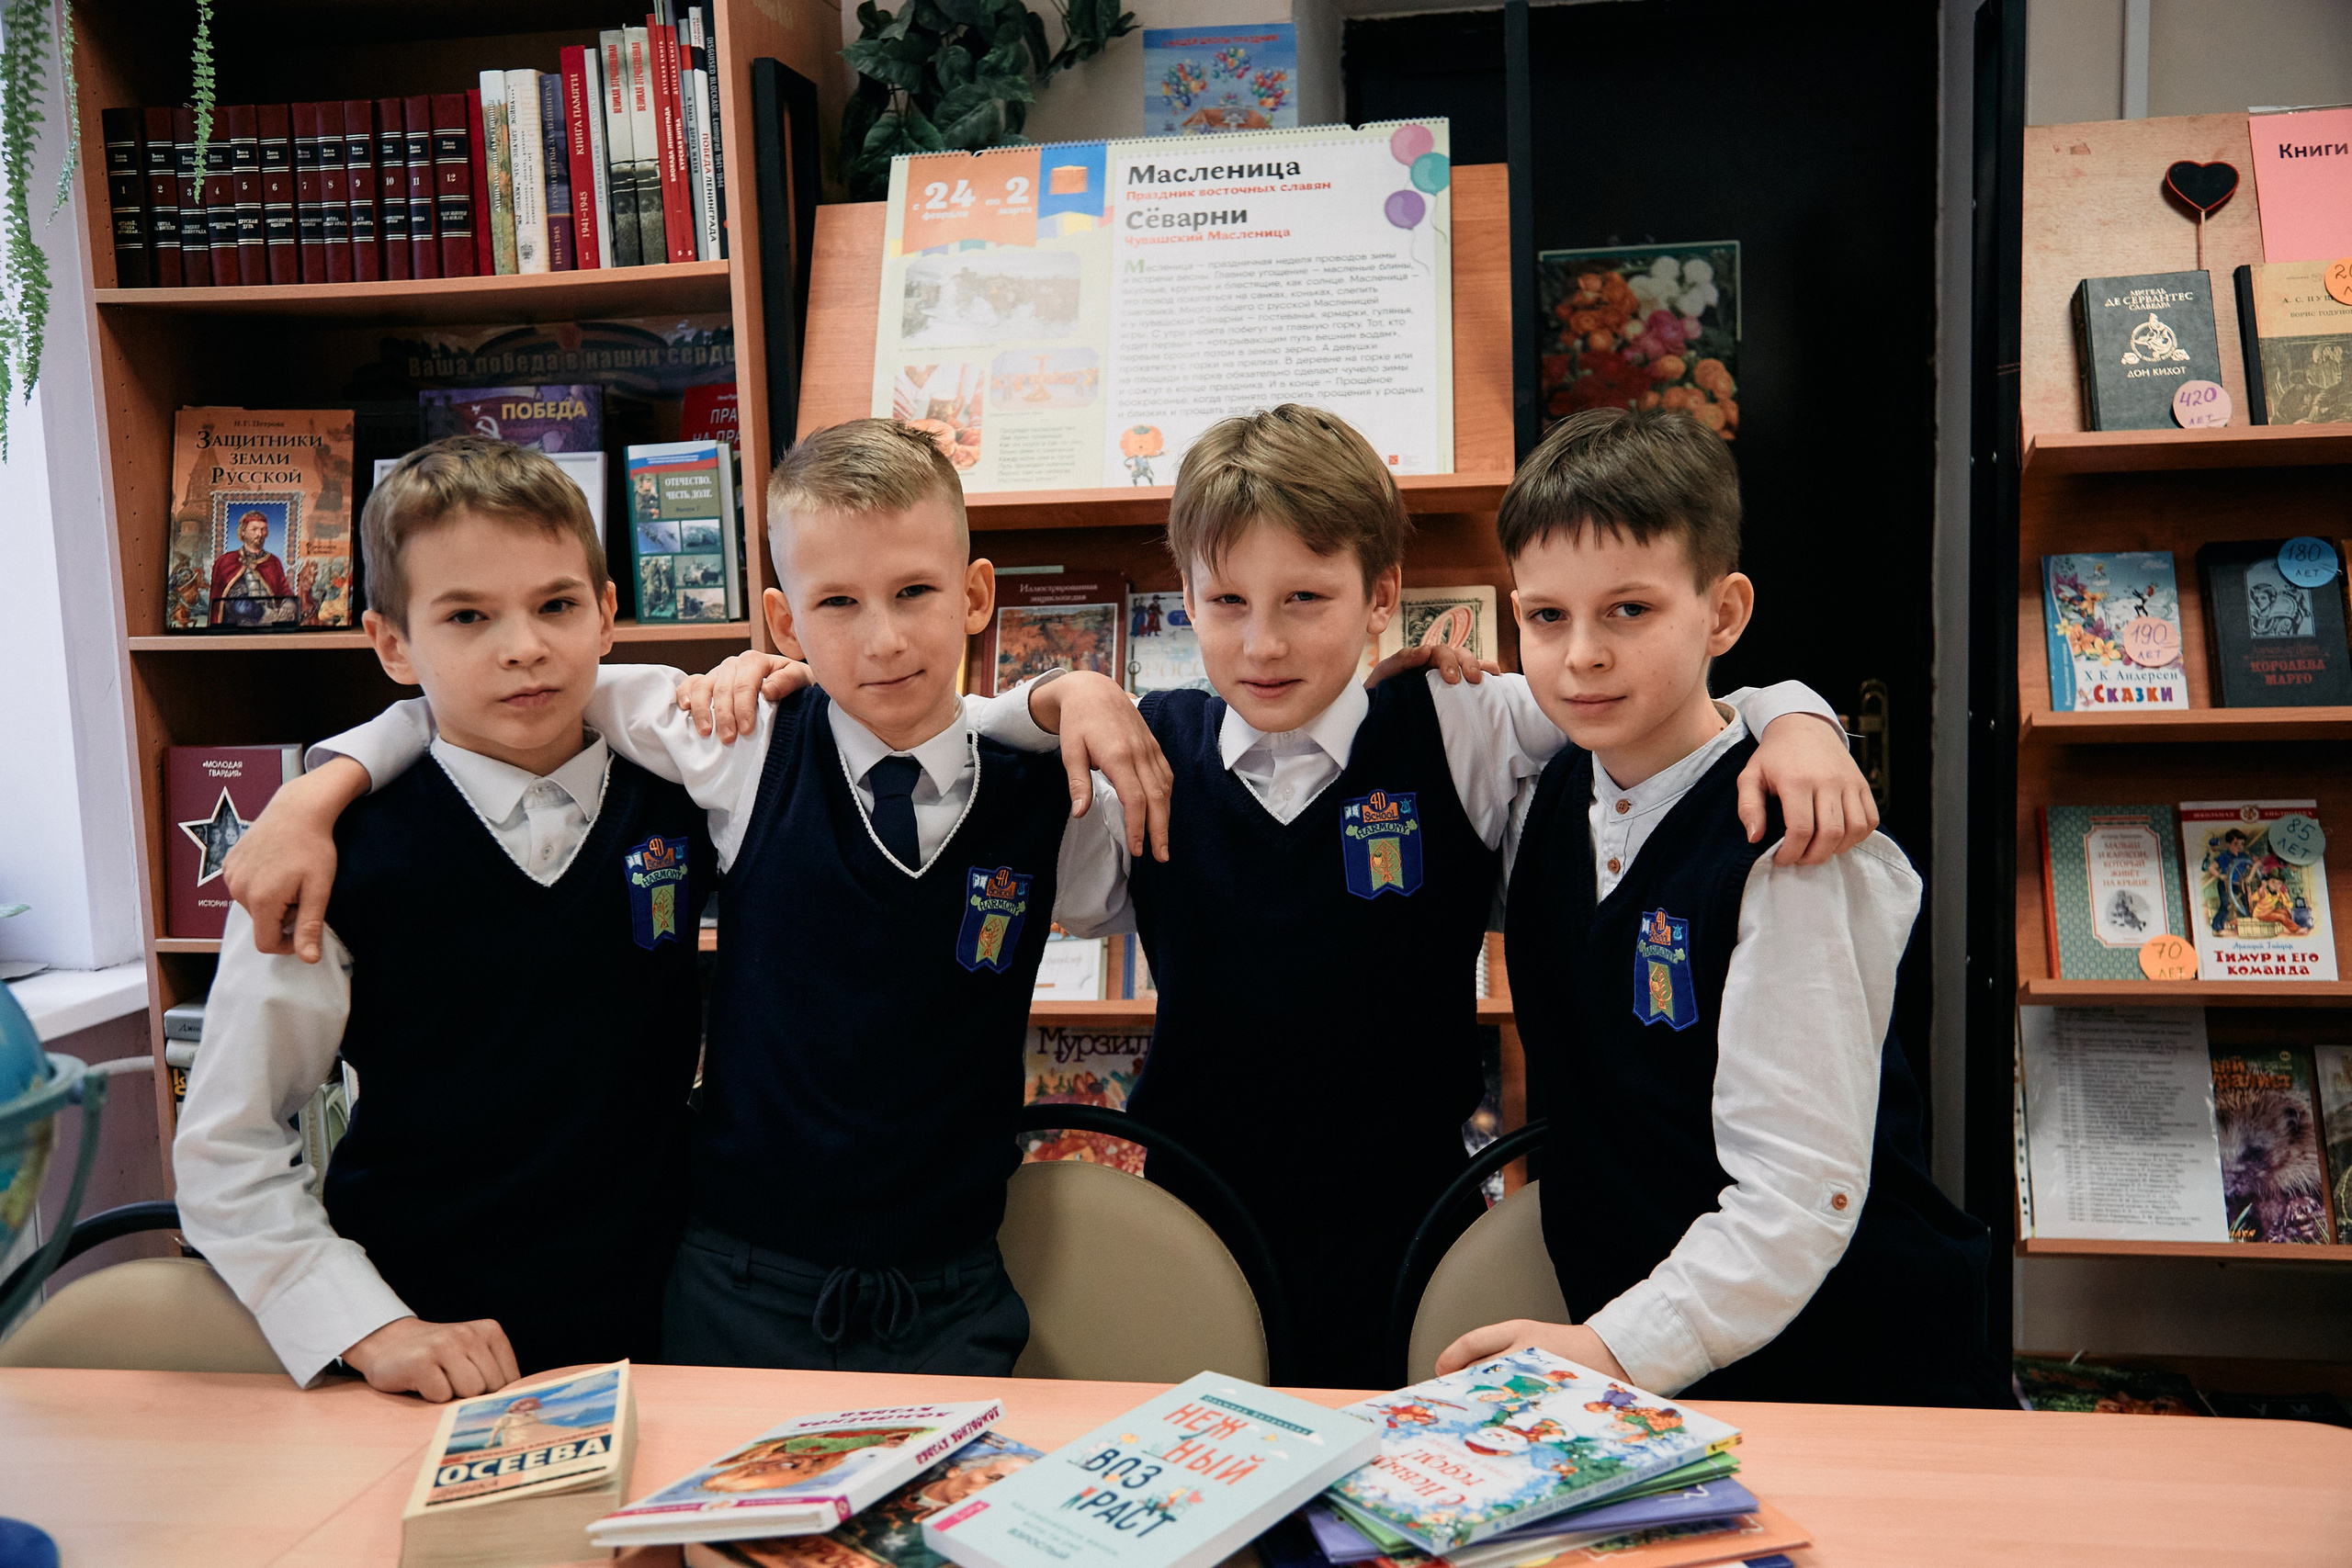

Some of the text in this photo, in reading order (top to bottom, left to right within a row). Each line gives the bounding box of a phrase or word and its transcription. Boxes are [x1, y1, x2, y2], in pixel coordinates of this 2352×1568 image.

[707, 37, 717, 73] DISGUISED
[661, 65, 669, 95] ДЕТСКАЯ
[612, 89, 622, 113] ВЕЛИКАЯ
[635, 86, 646, 111] ВЕЛИКАЯ
[570, 73, 584, 155] КНИГА ПАМЯТИ
[664, 107, 673, 149] ЛЕНИНГРАДА
[711, 118, 723, 152] Leningrad
[689, 127, 697, 150] ДОРОГА
[677, 141, 685, 171] КУРСКАЯ
[2278, 141, 2348, 159] Книги
[386, 176, 395, 186] 10
[413, 176, 420, 186] 11
[447, 173, 456, 182] 12
[1128, 160, 1303, 186] Масленица
[121, 186, 126, 195] 1
[187, 187, 193, 197] 3
[215, 186, 220, 195] 4
[243, 182, 248, 190] 5
[272, 183, 277, 191] 6
[328, 180, 334, 189] 8
[355, 179, 360, 187] 9
[702, 133, 717, 242] ПОБЕДА ЛЕНИНГРАДА
[985, 176, 1030, 207] по 2
[1125, 182, 1332, 201] Праздник восточных славян
[924, 178, 976, 209] 24
[1125, 206, 1248, 231] Сёварни
[1125, 227, 1292, 247] Чувашский Масленица
[1316, 254, 1368, 265] проводов
[1350, 274, 1408, 283] Масленица
[2104, 292, 2194, 307] ДЕ СЕРВАНТЕС
[2130, 288, 2167, 297] МИГЕЛЬ
[1267, 296, 1380, 310] русской Масленицей
[1332, 344, 1378, 353] девушки
[1361, 353, 1391, 362] горке
[2126, 366, 2188, 378] ДОН КИХОТ
[1317, 388, 1373, 398] прощения
[1384, 386, 1425, 396] родных
[2179, 386, 2218, 407] 420
[502, 400, 588, 423] ПОБЕДА
[230, 452, 290, 466] ЗЕМЛИ
[664, 476, 713, 487] ОТЕЧЕСТВО.
[2288, 544, 2322, 562] 180
[1020, 582, 1099, 593] Иллюстрированная
[2131, 623, 2167, 645] 190
[2251, 659, 2326, 672] КОРОЛЕВА
[2116, 669, 2178, 683] Андерсен
[2265, 672, 2312, 686] МАРГО
[1363, 809, 1398, 821] SCHOOL
[1356, 822, 1408, 839] HARMONY
[2286, 818, 2316, 841] 85
[2277, 838, 2312, 860] ЛЕТ
[641, 869, 683, 887] HARMONY
[198, 899, 228, 908] ИСТОРИЯ
[978, 898, 1020, 916] HARMONY
[2152, 941, 2182, 961] 70
[1036, 1026, 1152, 1064] Мурзил
[1162, 1403, 1250, 1440] НЕЖ
[914, 1404, 1000, 1465] ДОМОВЁНОК КУЗЬКА
[437, 1437, 606, 1486] ОСЕЕВА
[1088, 1448, 1164, 1490] ВОЗ
[1161, 1438, 1266, 1486] НЫЙ
[1077, 1490, 1179, 1538] РАСТ
